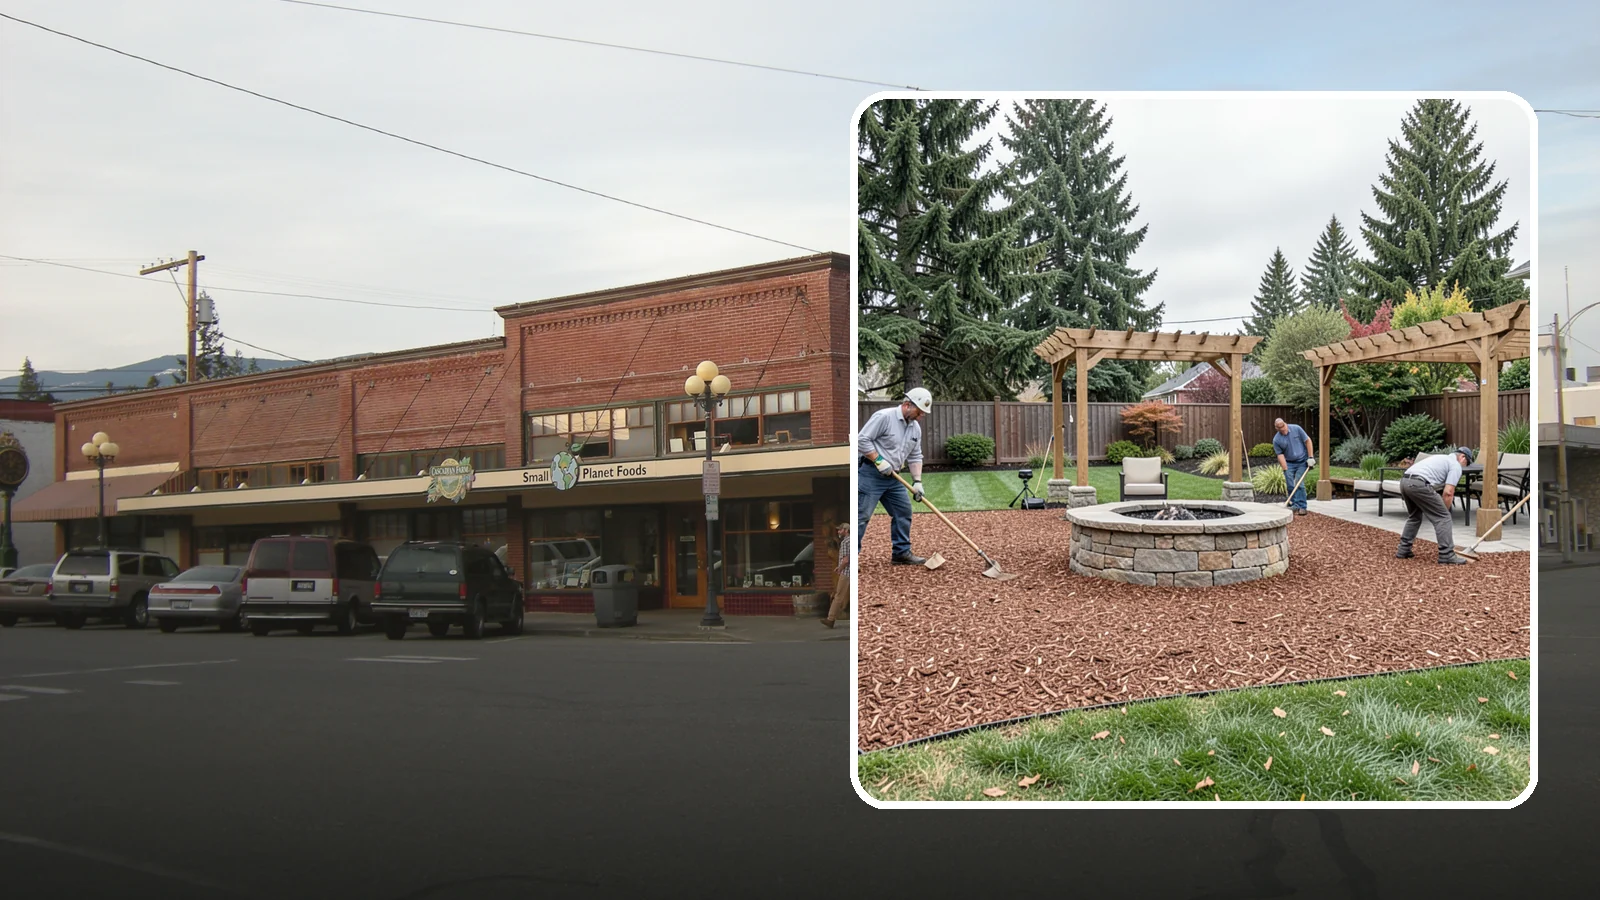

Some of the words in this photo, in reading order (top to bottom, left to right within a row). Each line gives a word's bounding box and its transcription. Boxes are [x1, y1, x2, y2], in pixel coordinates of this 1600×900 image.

[523, 471, 549, 483] Small
[583, 467, 614, 479] Planet
[617, 464, 647, 477] Foods
